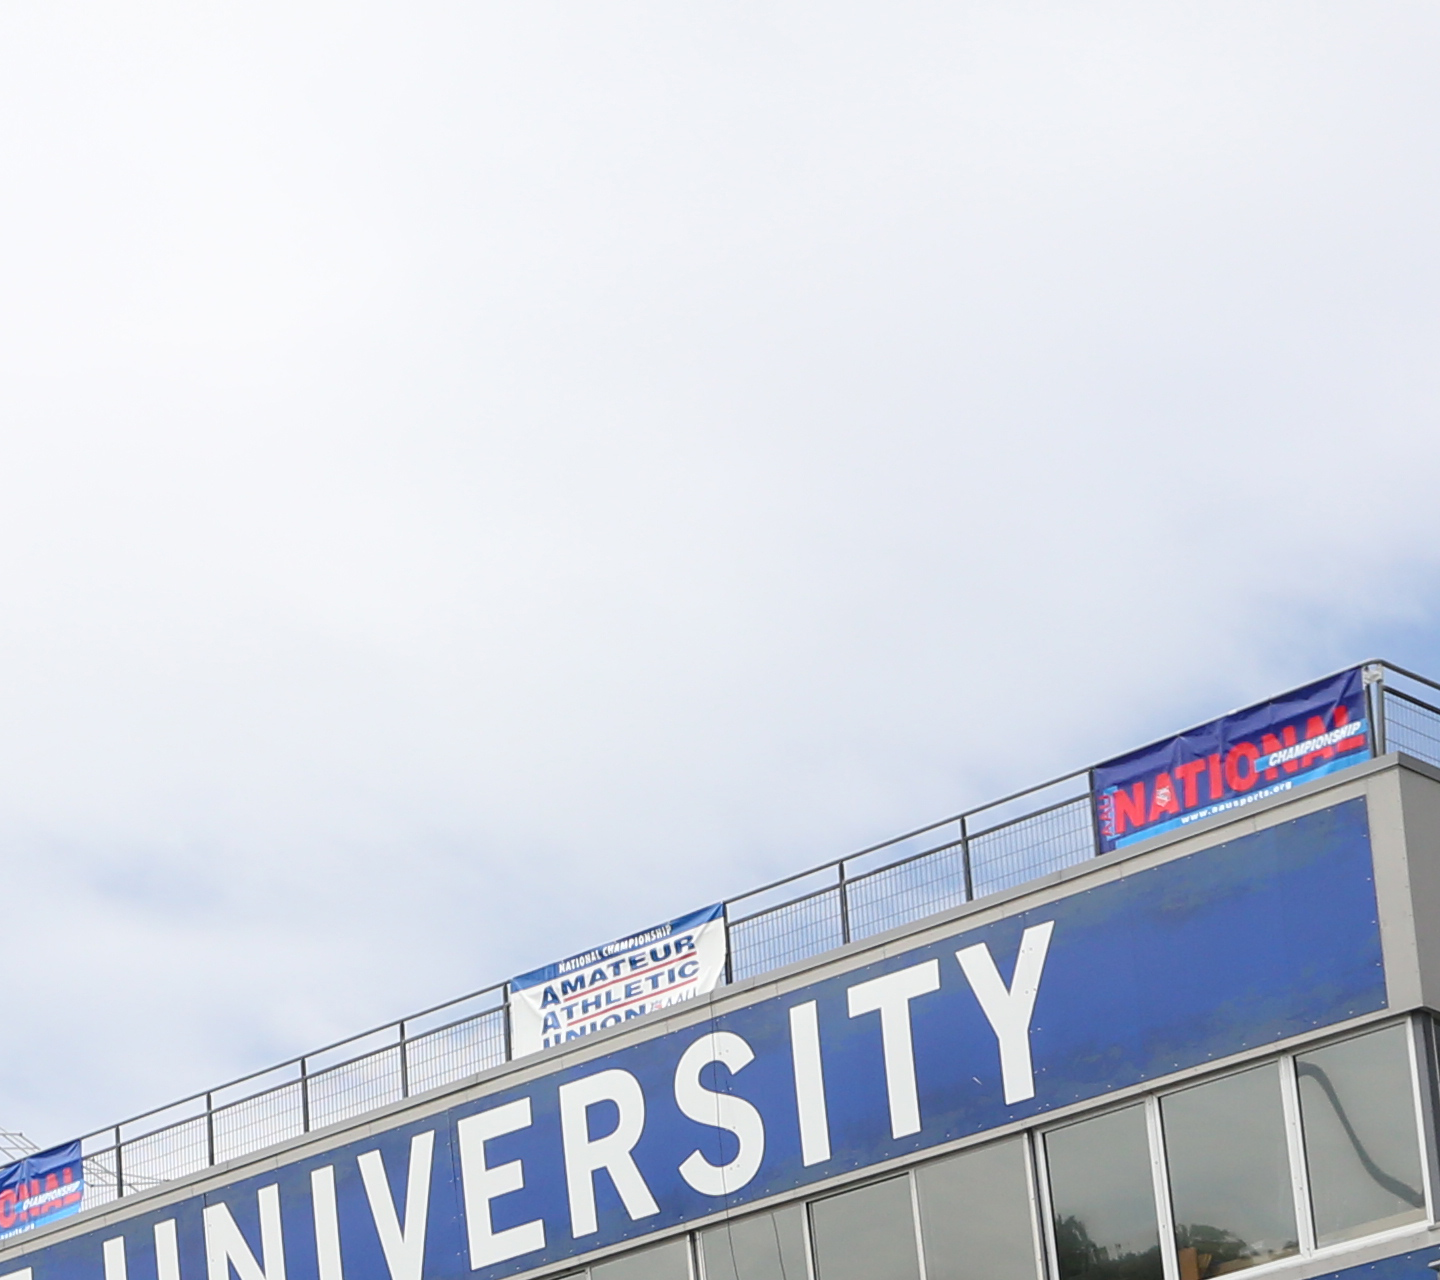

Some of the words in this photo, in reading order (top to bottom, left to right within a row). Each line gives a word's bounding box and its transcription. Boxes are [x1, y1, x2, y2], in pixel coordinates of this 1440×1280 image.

[1113, 705, 1366, 834] NATIONAL
[1268, 721, 1362, 766] CHAMPIONSHIP
[540, 934, 696, 1010] AMATEUR
[558, 951, 601, 974] NATIONAL
[602, 924, 672, 957] CHAMPIONSHIP
[541, 960, 700, 1035] ATHLETIC
